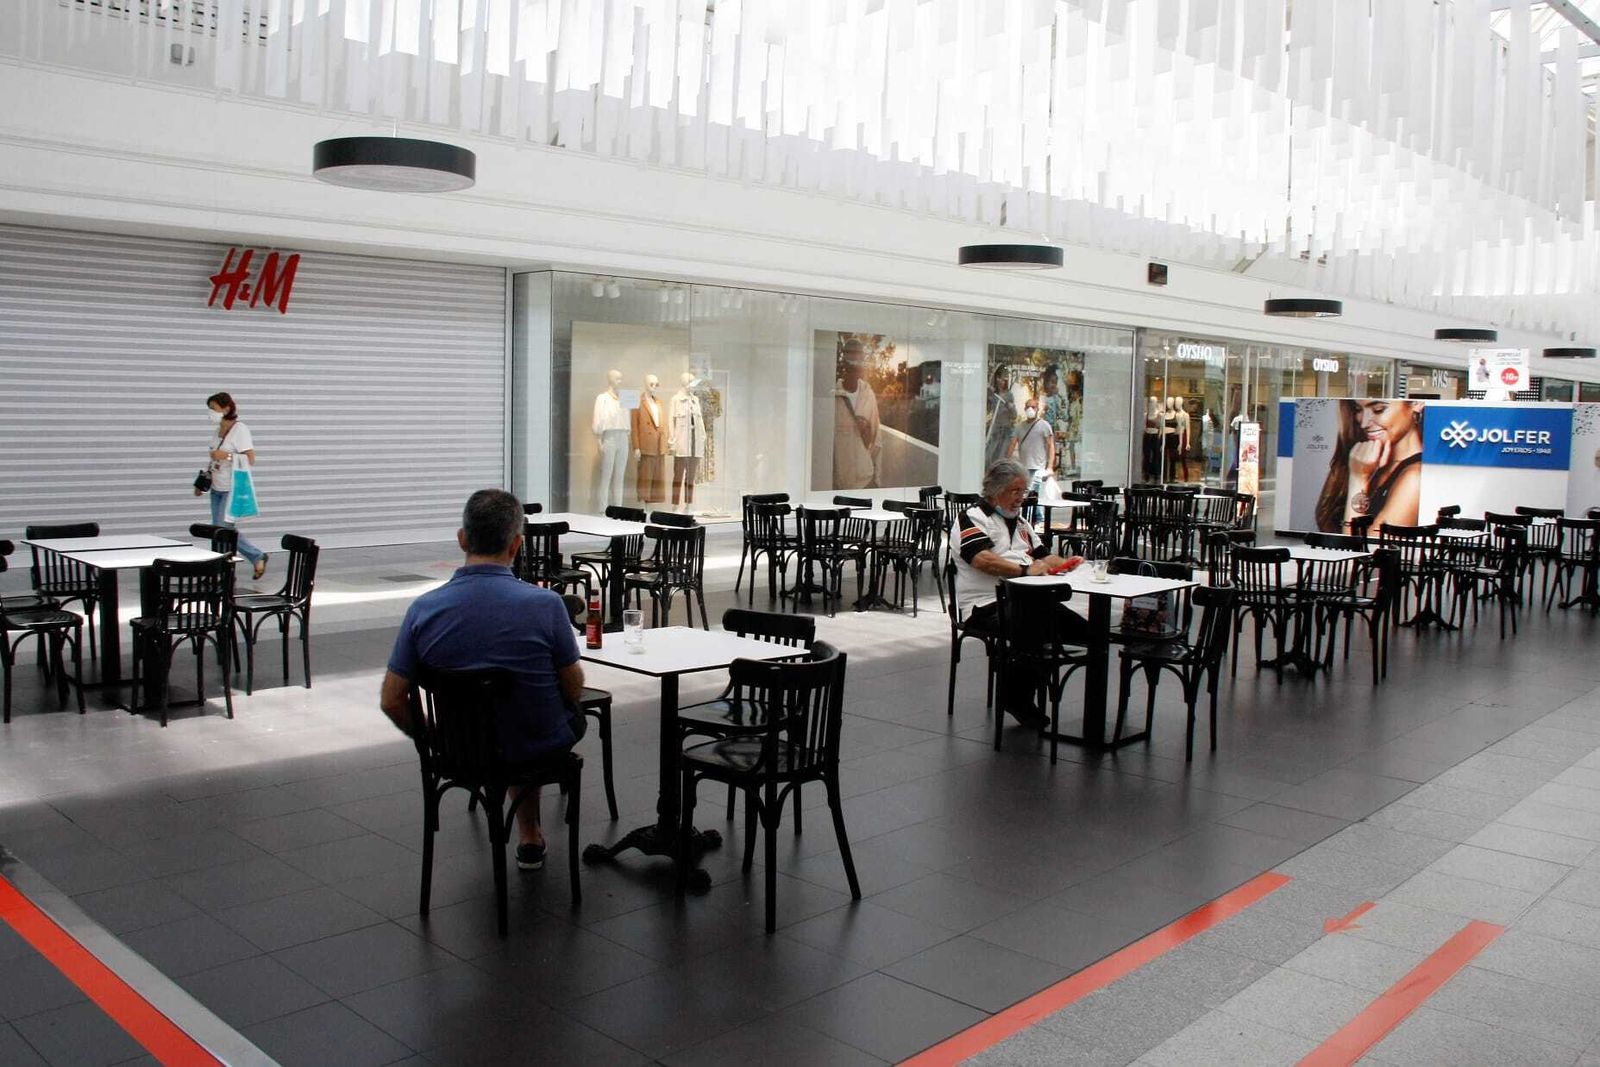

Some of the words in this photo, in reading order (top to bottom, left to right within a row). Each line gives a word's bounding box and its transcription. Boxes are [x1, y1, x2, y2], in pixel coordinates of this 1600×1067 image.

[208, 247, 301, 315] H&M
[1177, 343, 1212, 361] OYSHO
[1313, 358, 1339, 373] OYSHO
[1477, 429, 1550, 444] JOLFER
